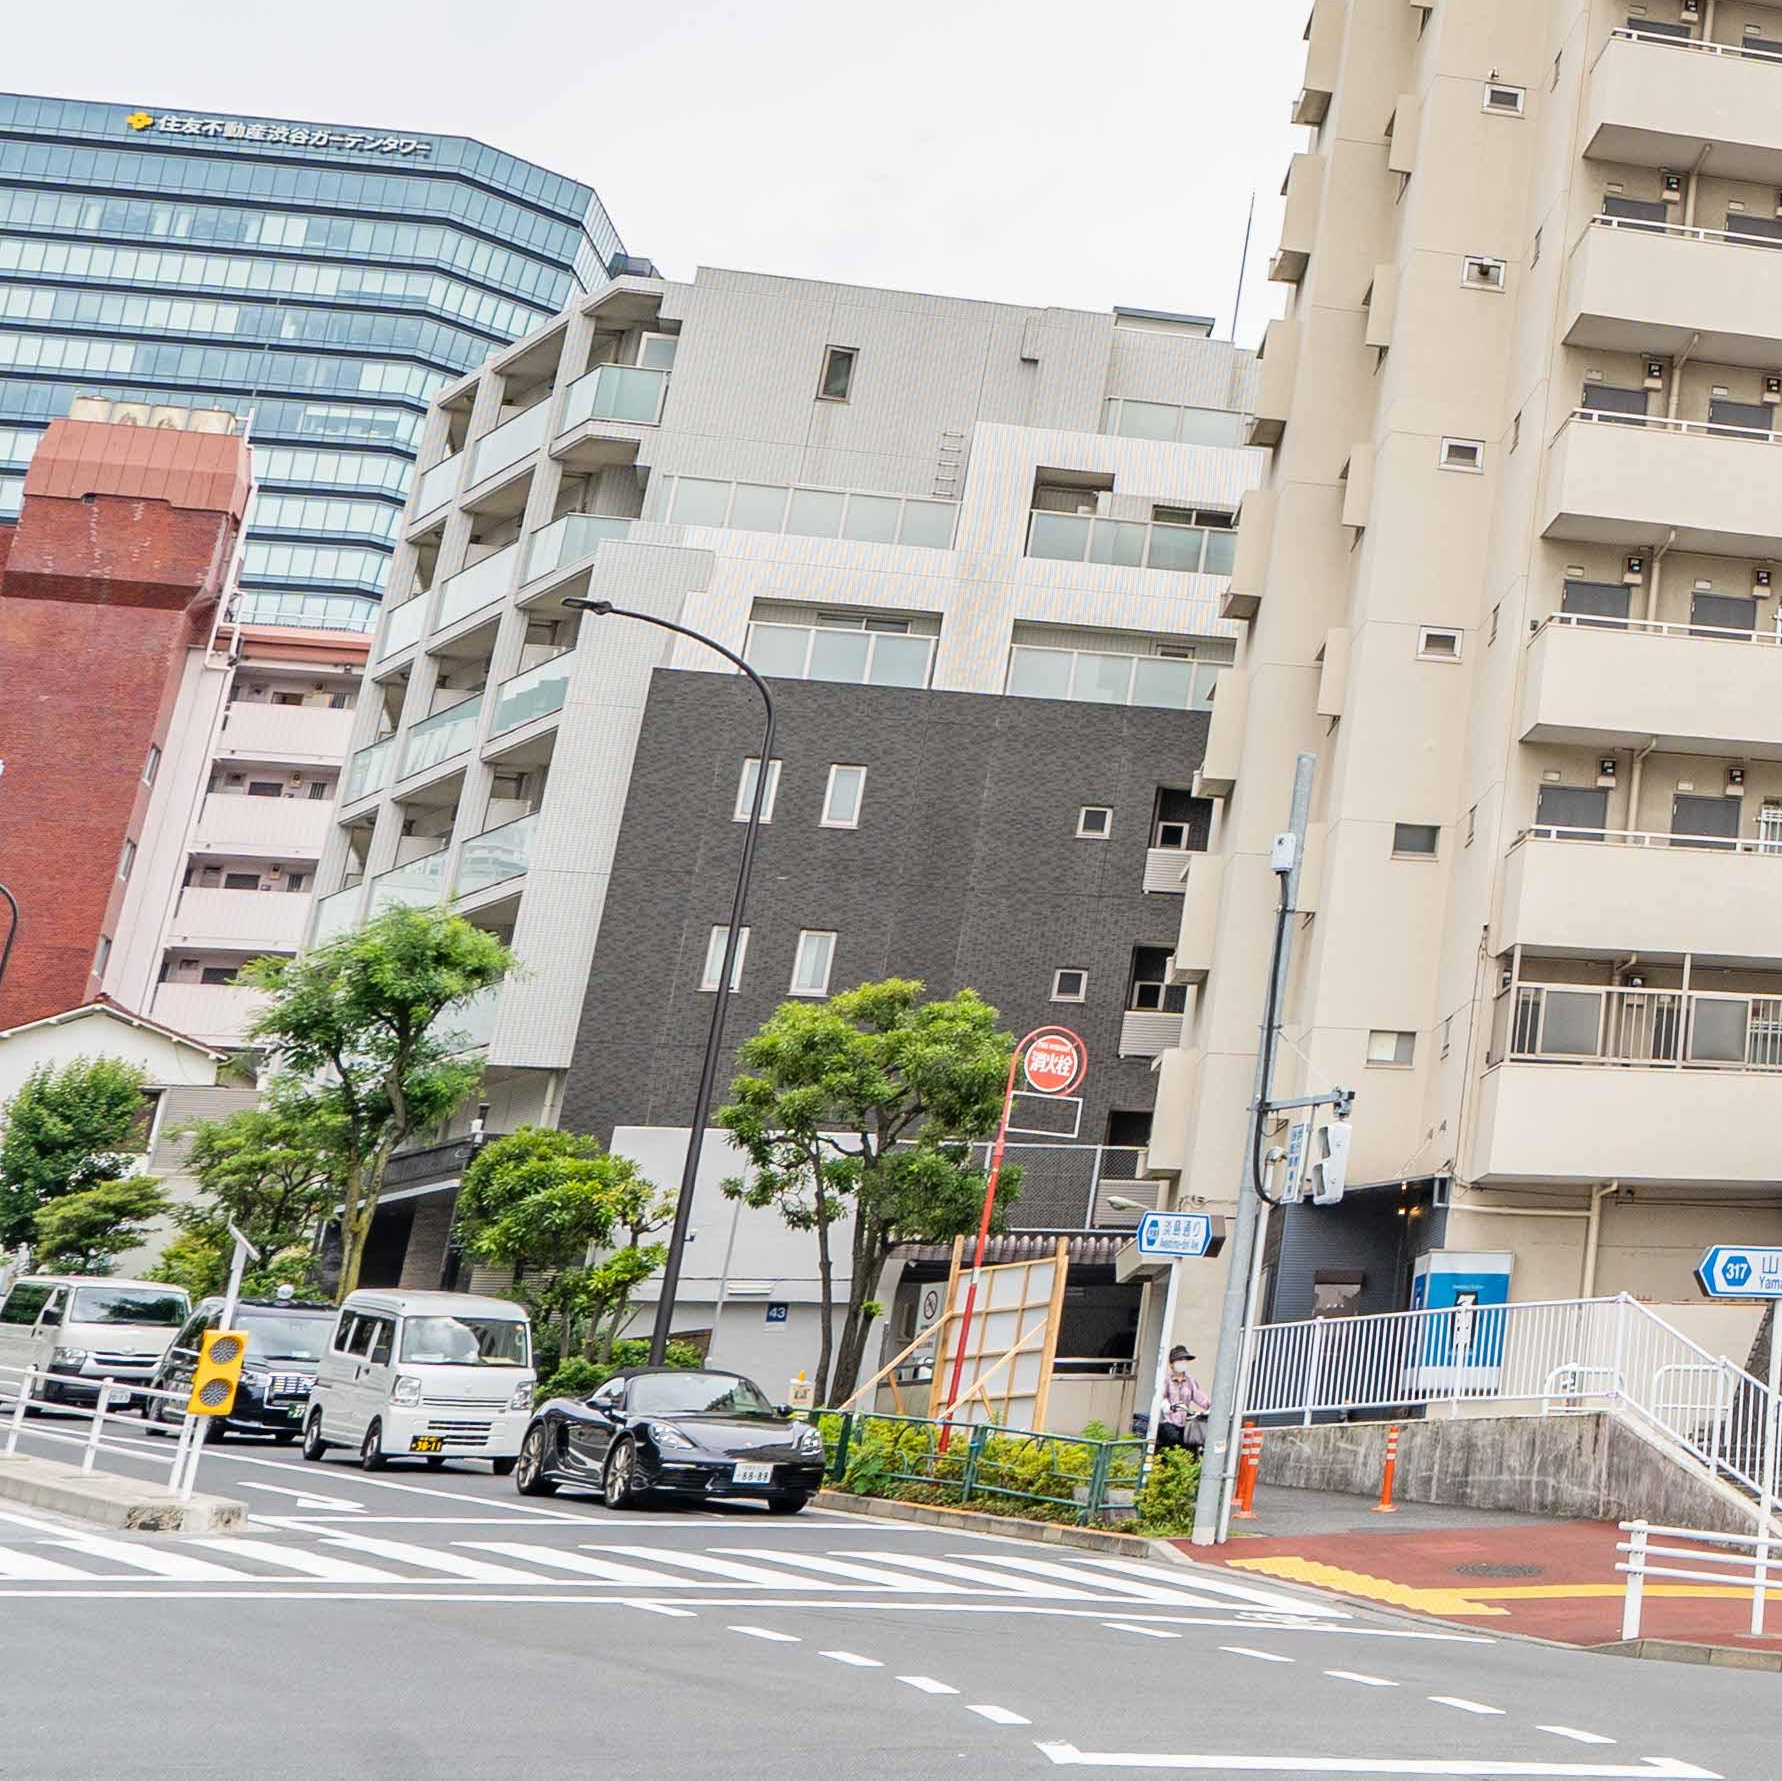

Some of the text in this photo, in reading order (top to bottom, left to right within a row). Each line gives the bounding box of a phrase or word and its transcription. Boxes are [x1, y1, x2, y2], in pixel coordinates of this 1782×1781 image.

[158, 114, 431, 154] 住友不動産渋谷ガーデンタワー
[1029, 1050, 1073, 1077] 消火栓
[1726, 1262, 1749, 1280] 317
[769, 1307, 786, 1319] 43
